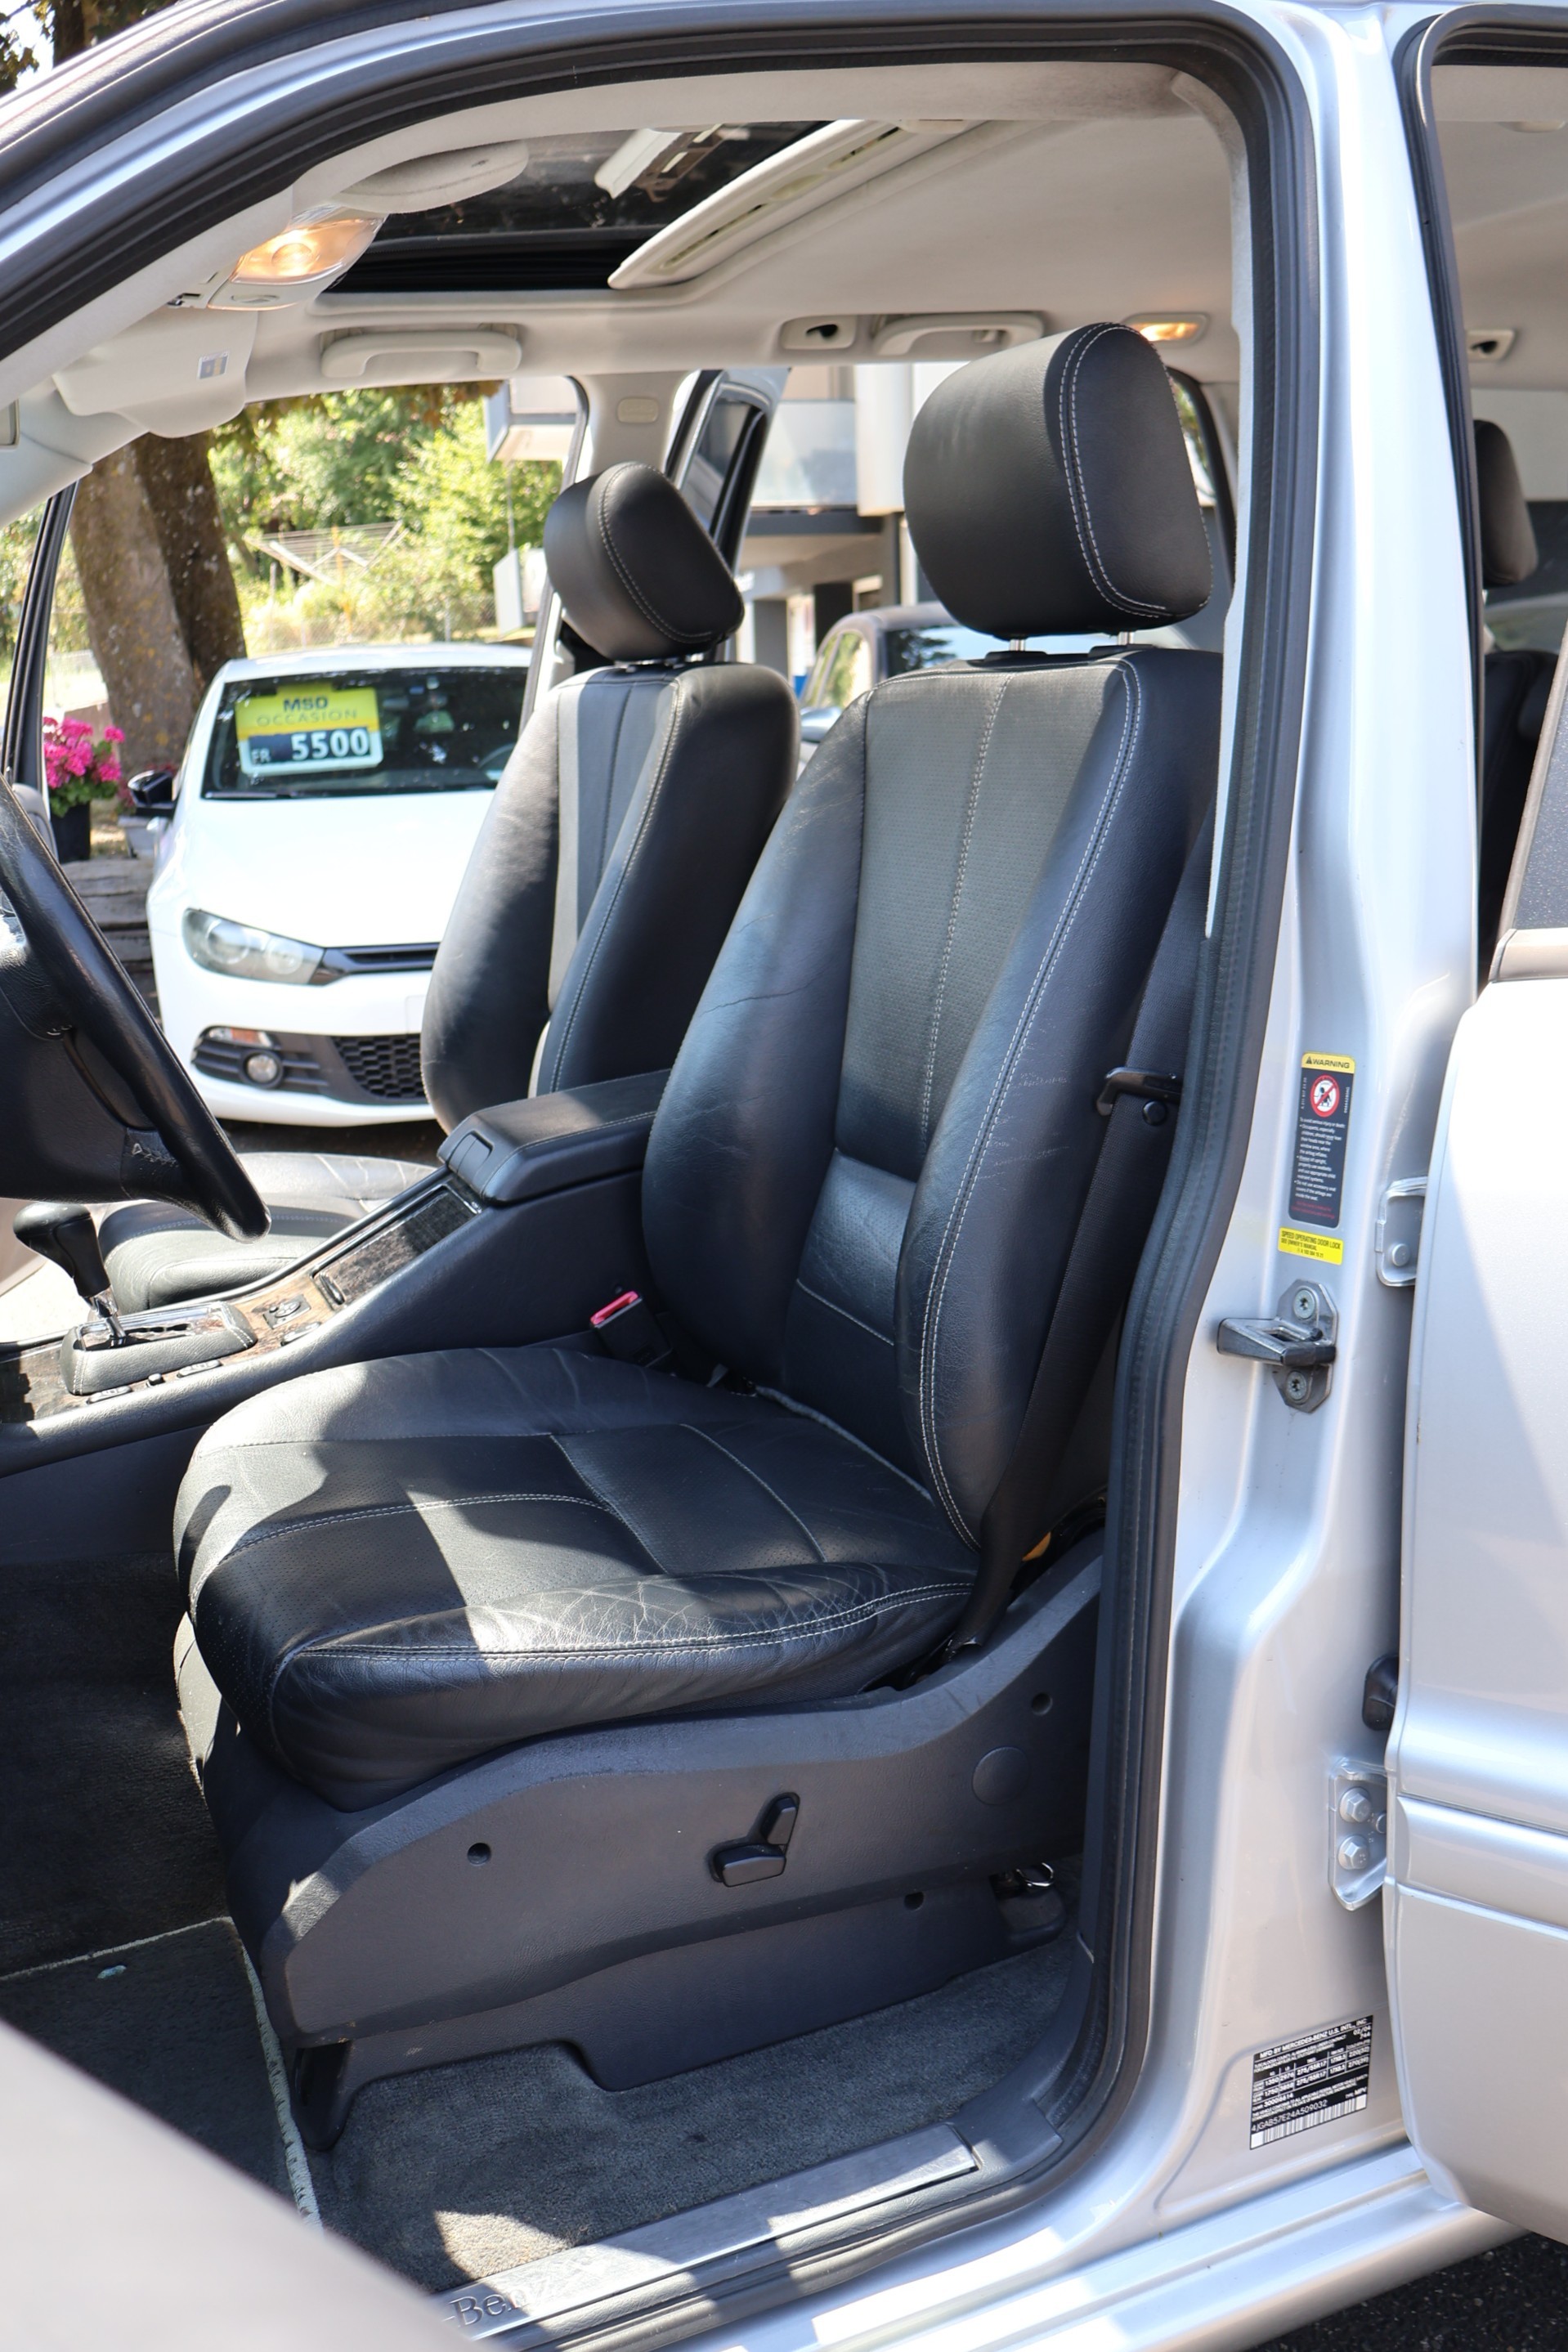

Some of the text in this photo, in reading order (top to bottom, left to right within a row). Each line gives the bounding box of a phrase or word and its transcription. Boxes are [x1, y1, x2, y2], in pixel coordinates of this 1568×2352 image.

[284, 697, 328, 712] MSD
[257, 710, 357, 726] OCCASION
[291, 728, 370, 761] 5500
[1313, 1059, 1350, 1068] WARNING
[1329, 1241, 1341, 1249] LOCK
[1283, 2032, 1328, 2051] MERCEDES-BENZ
